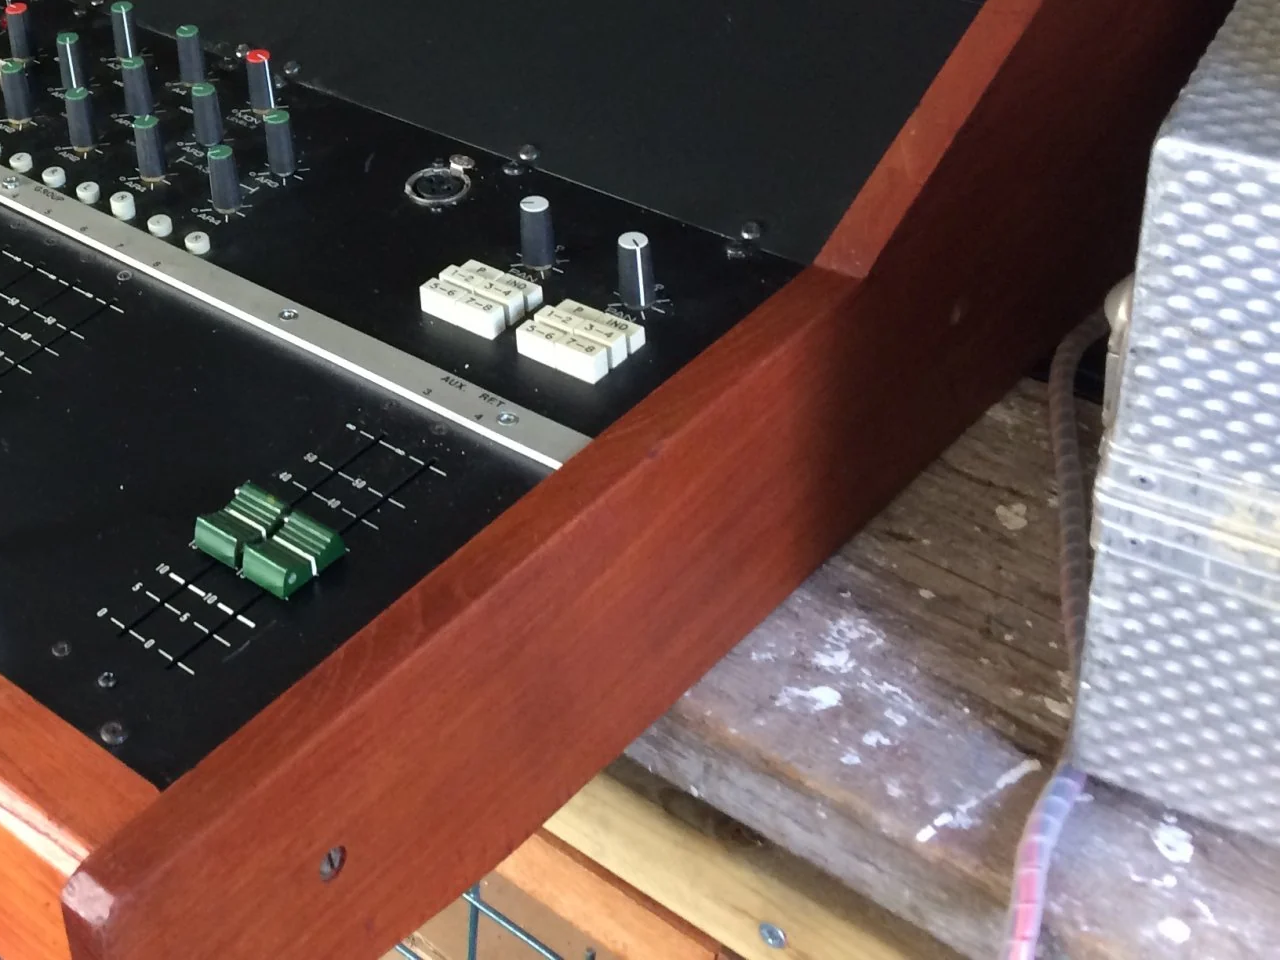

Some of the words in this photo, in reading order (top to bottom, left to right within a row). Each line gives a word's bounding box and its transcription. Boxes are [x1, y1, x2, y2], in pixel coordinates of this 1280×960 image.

[450, 269, 475, 283] 1-2
[476, 267, 486, 275] P
[430, 283, 455, 297] 5-6
[484, 282, 512, 297] 3-4
[506, 279, 528, 290] IND
[465, 297, 493, 311] 7-8
[573, 306, 584, 315] P
[546, 310, 573, 325] 1-2
[583, 323, 614, 339] 3-4
[606, 318, 629, 331] IND
[526, 325, 554, 340] 5-6
[568, 338, 595, 353] 7-8
[478, 393, 506, 408] RET
[155, 563, 170, 575] 10
[131, 582, 143, 592] 5
[203, 592, 218, 605] 10
[96, 607, 108, 617] 0
[179, 612, 191, 623] 5
[143, 638, 156, 649] 0
